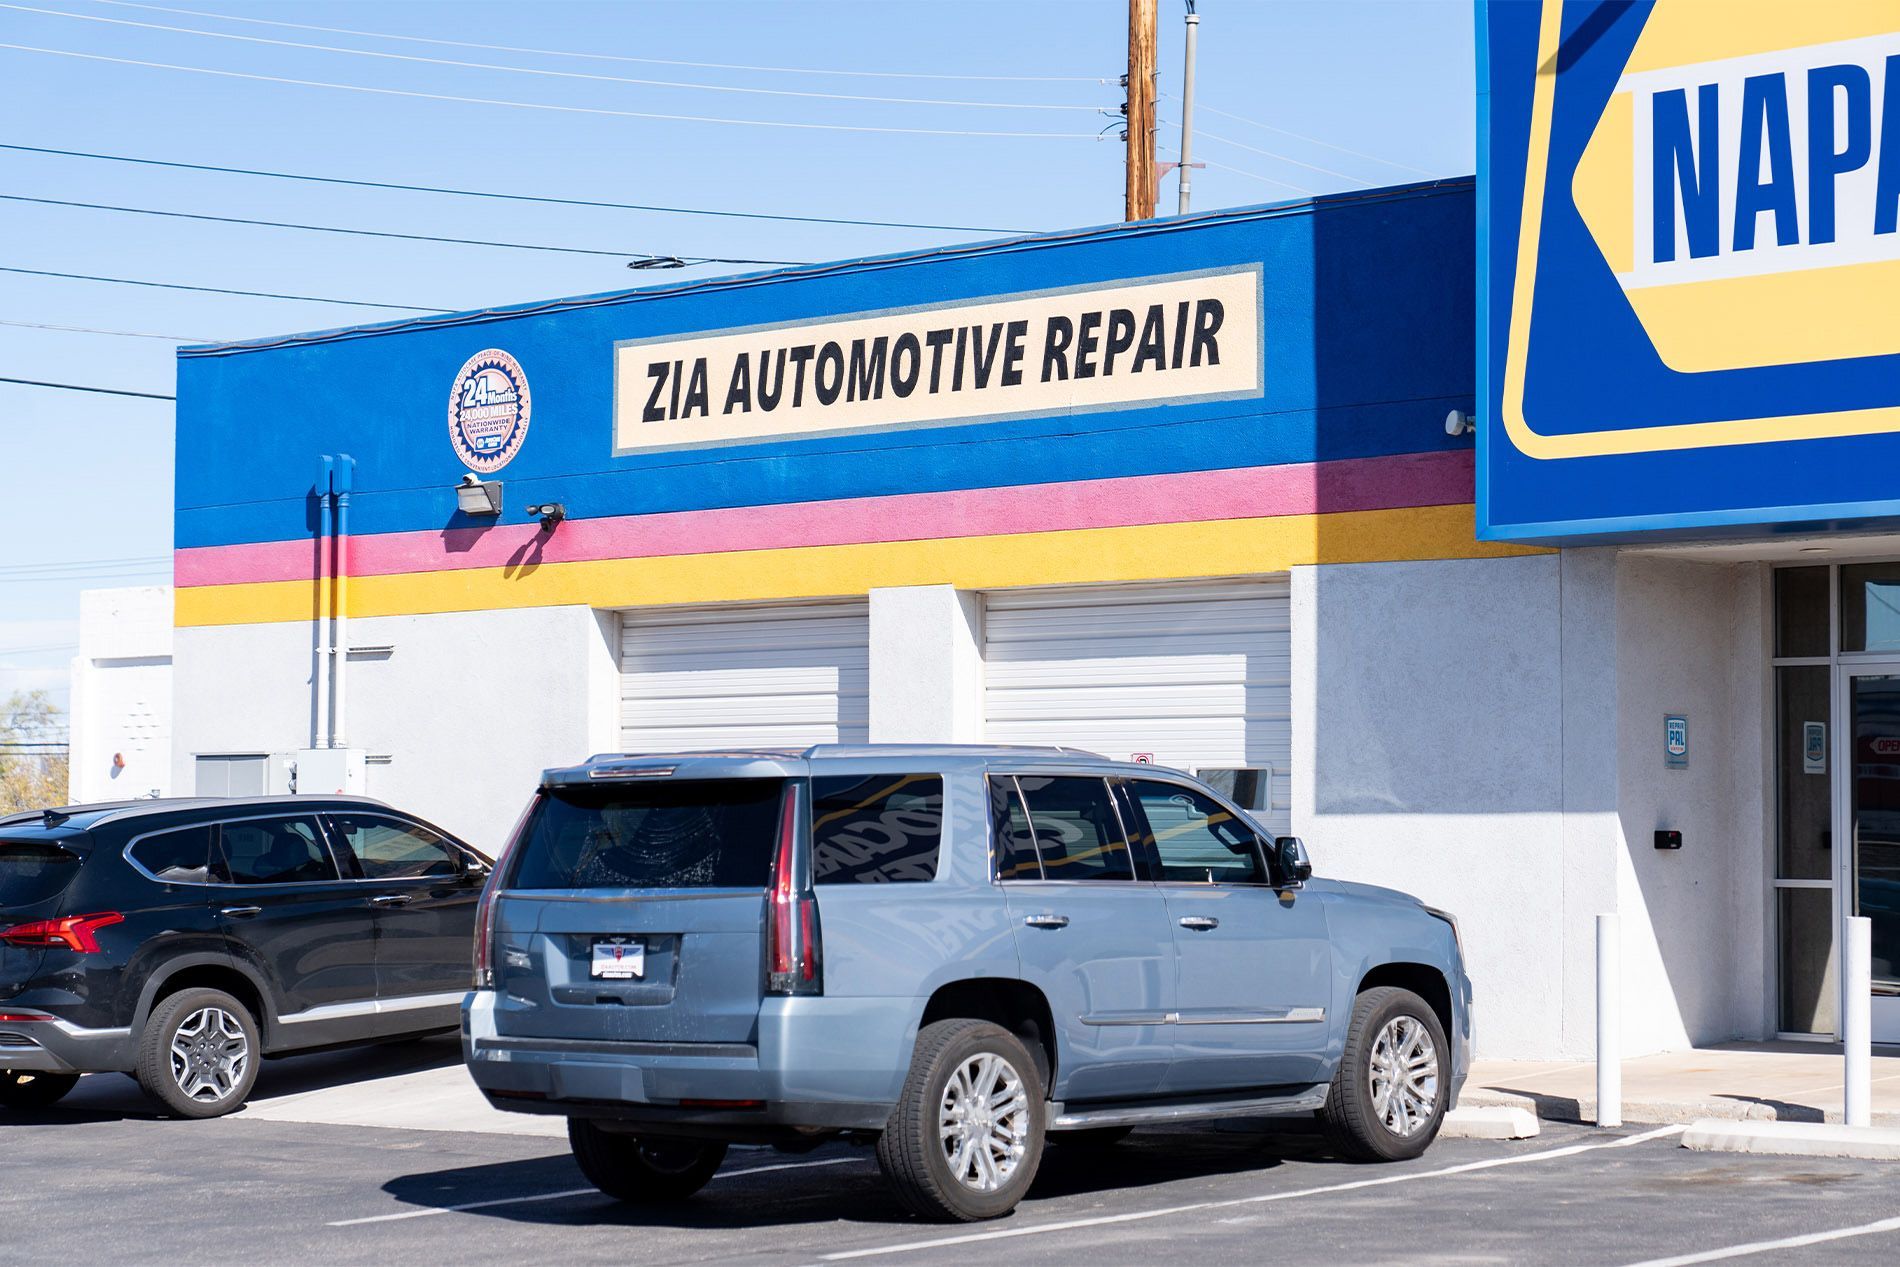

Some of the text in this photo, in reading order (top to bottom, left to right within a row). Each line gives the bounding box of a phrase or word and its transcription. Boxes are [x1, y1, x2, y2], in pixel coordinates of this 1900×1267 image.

[642, 297, 1225, 423] ZIA AUTOMOTIVE REPAIR
[463, 377, 518, 407] 24 Months
[459, 401, 518, 422] 24,000 MILES
[467, 418, 510, 429] NATIONWIDE
[469, 425, 508, 434] WARRANTY
[1669, 730, 1685, 746] PAL
